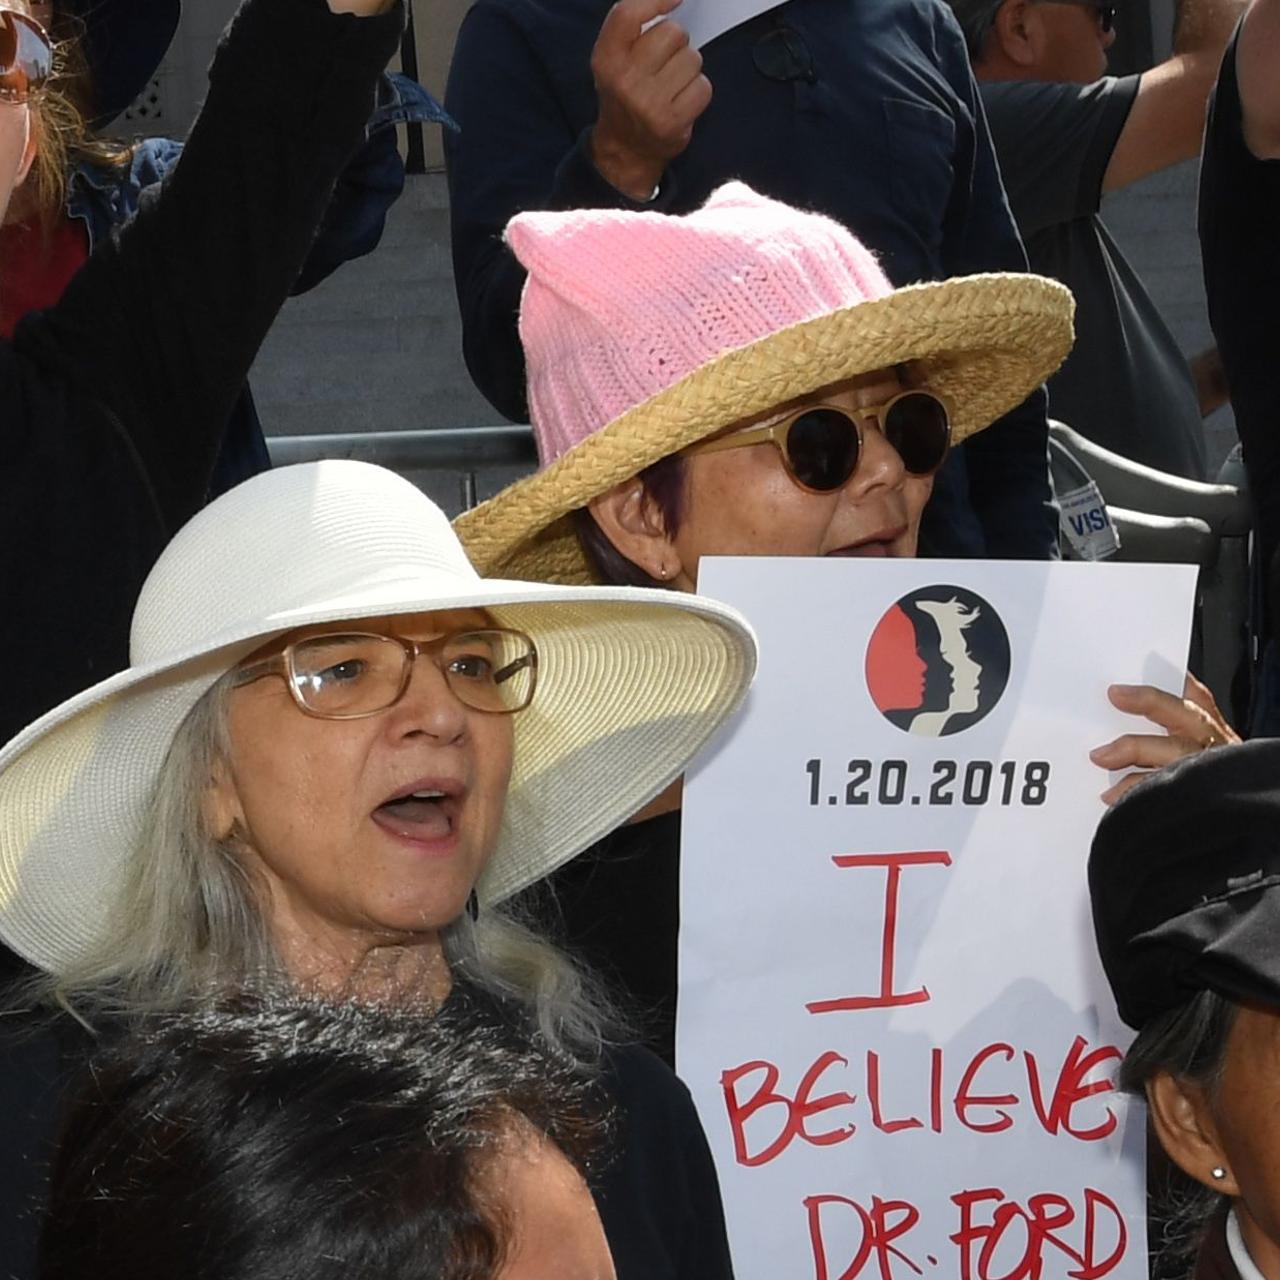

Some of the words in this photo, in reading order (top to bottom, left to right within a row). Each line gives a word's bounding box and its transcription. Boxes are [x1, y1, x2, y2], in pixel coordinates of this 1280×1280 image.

[807, 760, 1049, 805] 1.20.2018
[805, 852, 951, 1013] I
[720, 1035, 1126, 1166] BELIEVE
